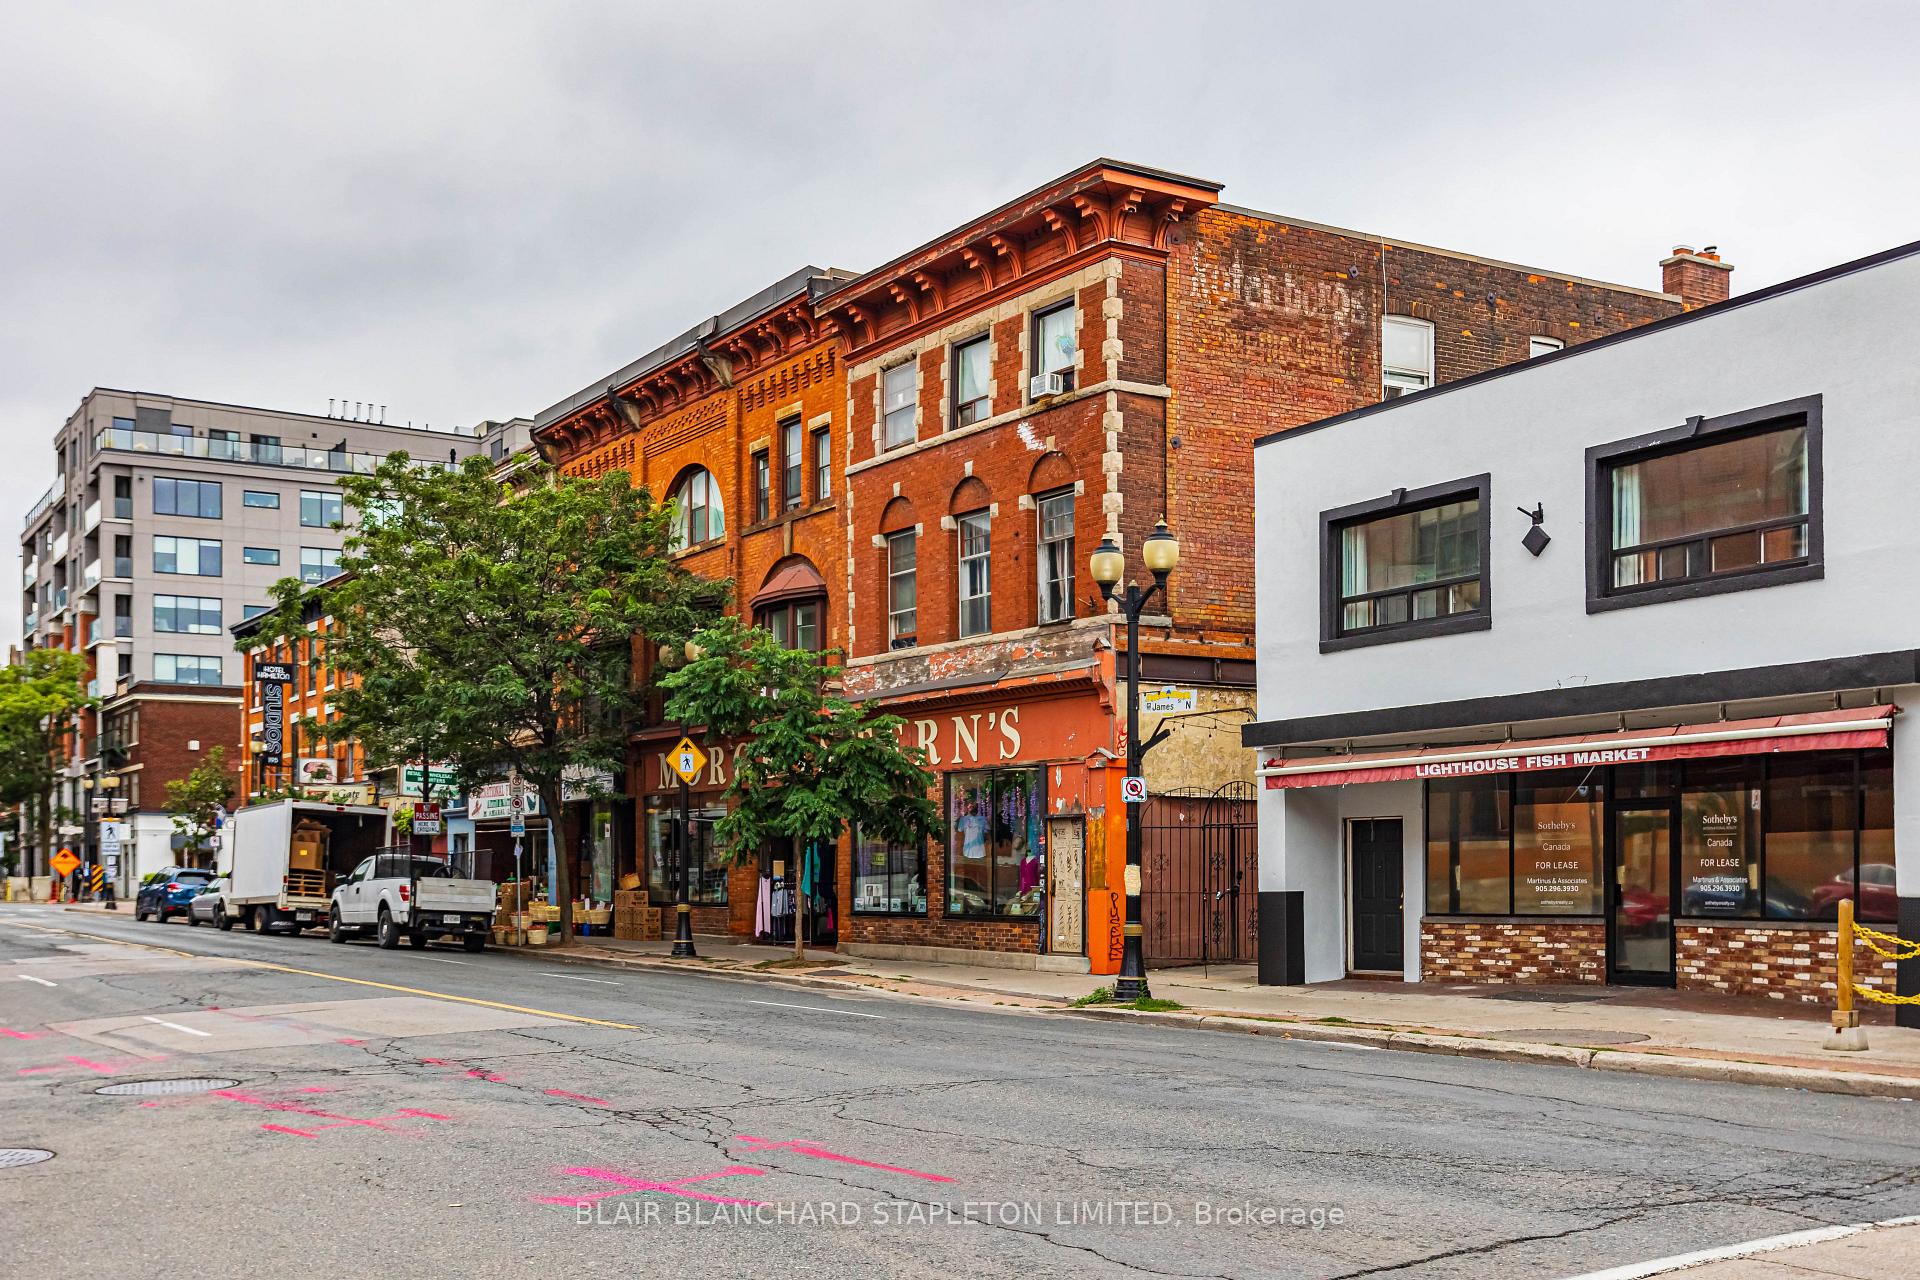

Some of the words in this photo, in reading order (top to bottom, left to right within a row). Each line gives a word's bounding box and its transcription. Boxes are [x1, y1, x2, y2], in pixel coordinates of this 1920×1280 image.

[1152, 702, 1174, 711] James
[1185, 701, 1191, 709] N
[265, 683, 283, 754] STUDIOS
[1416, 757, 1519, 776] LIGHTHOUSE
[1526, 753, 1566, 769] FISH
[1573, 748, 1650, 764] MARKET
[1702, 814, 1737, 825] Sotheby's
[1538, 821, 1576, 831] Sotheby's
[1542, 843, 1571, 851] Canada
[1707, 838, 1733, 847] Canada
[1700, 859, 1715, 867] FOR
[1716, 859, 1740, 867] LEASE
[1700, 884, 1740, 892] 905.296.3930
